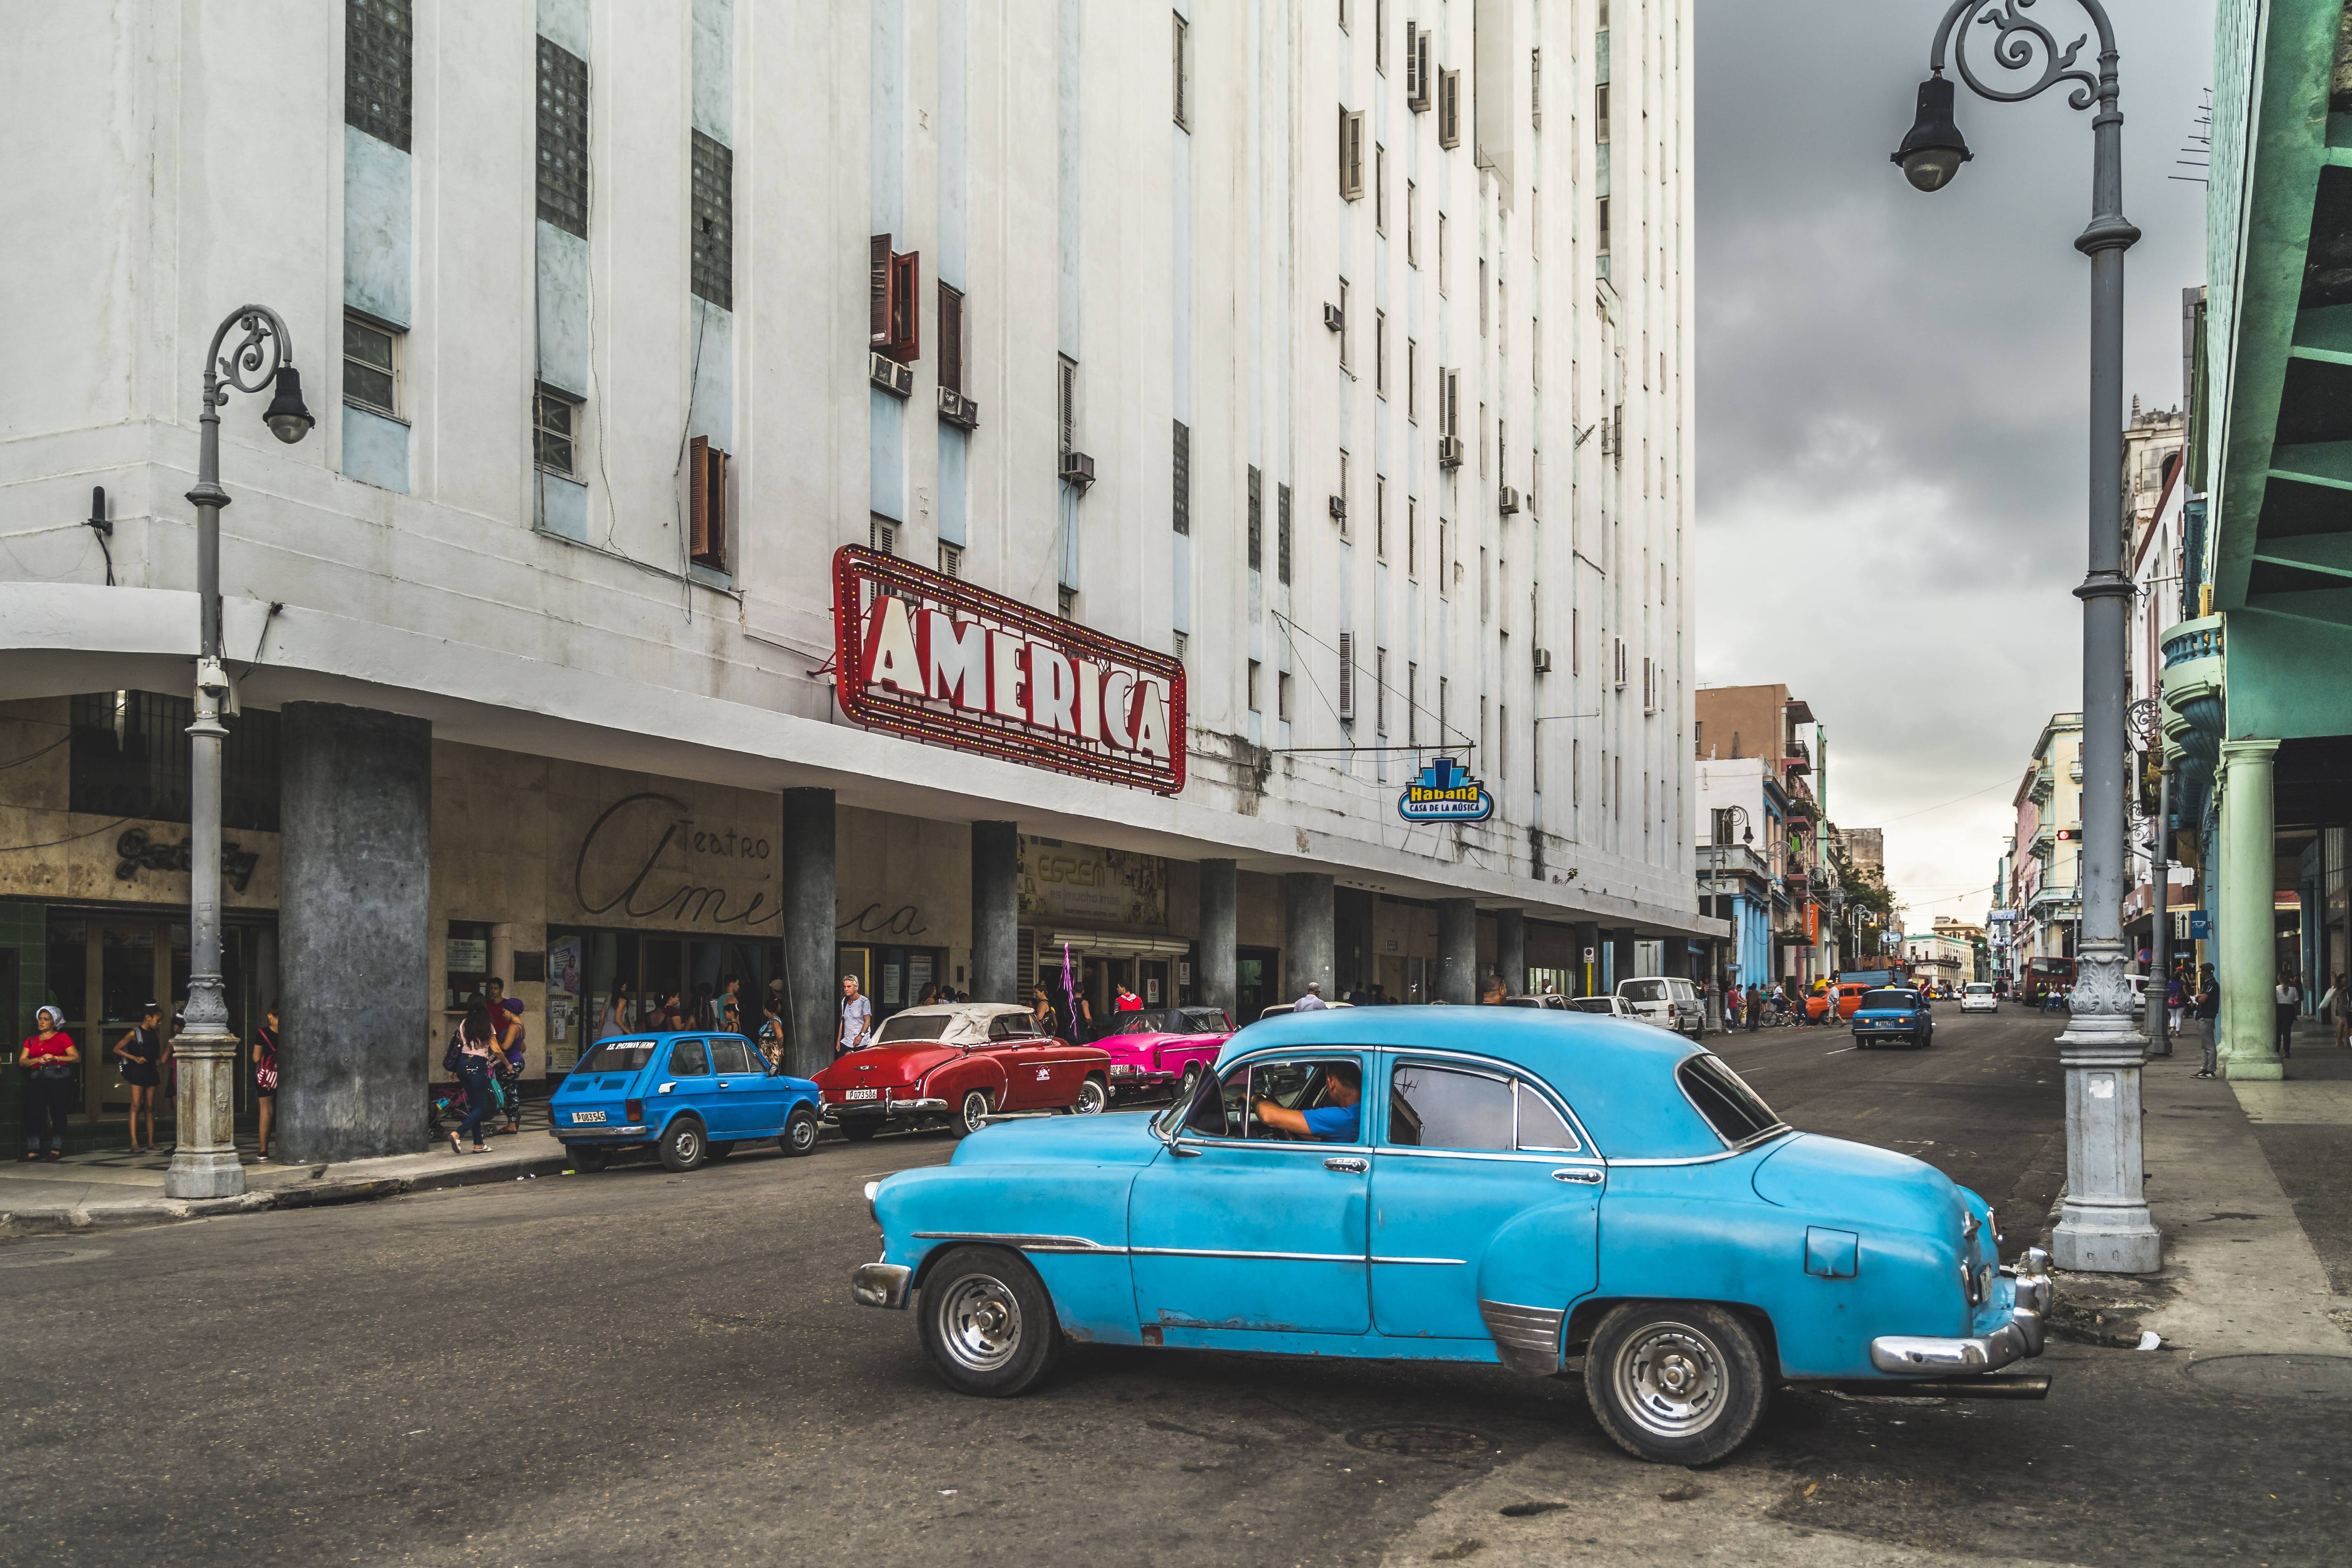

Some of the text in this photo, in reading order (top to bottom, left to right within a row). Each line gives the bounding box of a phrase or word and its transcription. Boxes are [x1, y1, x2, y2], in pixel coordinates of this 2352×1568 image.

[863, 595, 1170, 761] AMERICA
[1411, 786, 1477, 801] Habana
[1451, 803, 1479, 812] MÚSICA
[1050, 889, 1062, 899] es
[1066, 891, 1097, 903] mucho
